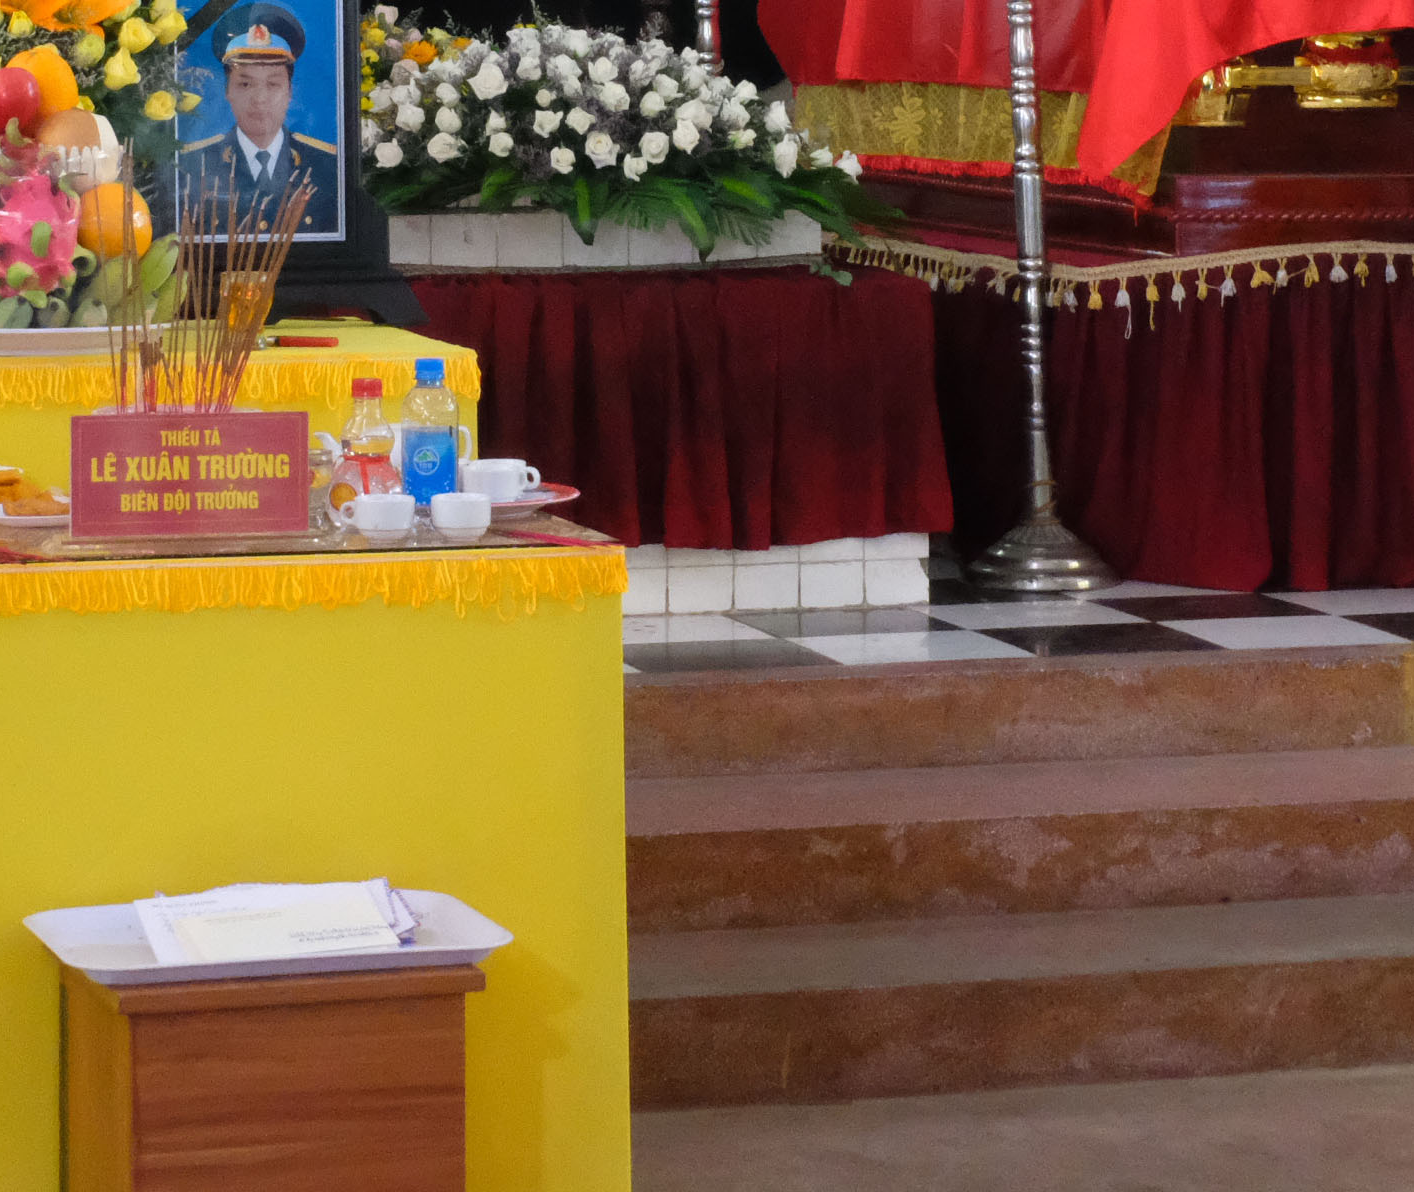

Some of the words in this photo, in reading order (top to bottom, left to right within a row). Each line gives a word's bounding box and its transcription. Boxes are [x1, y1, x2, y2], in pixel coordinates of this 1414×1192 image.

[160, 425, 200, 447] THIẾU
[204, 426, 222, 447] TÁ
[91, 451, 117, 482] LÊ
[125, 450, 191, 482] XUÂN
[197, 447, 291, 480] TRƯỜNG
[120, 490, 160, 512] BIÊN
[163, 489, 191, 515] ĐỘI
[195, 484, 260, 510] TRƯỞNG
